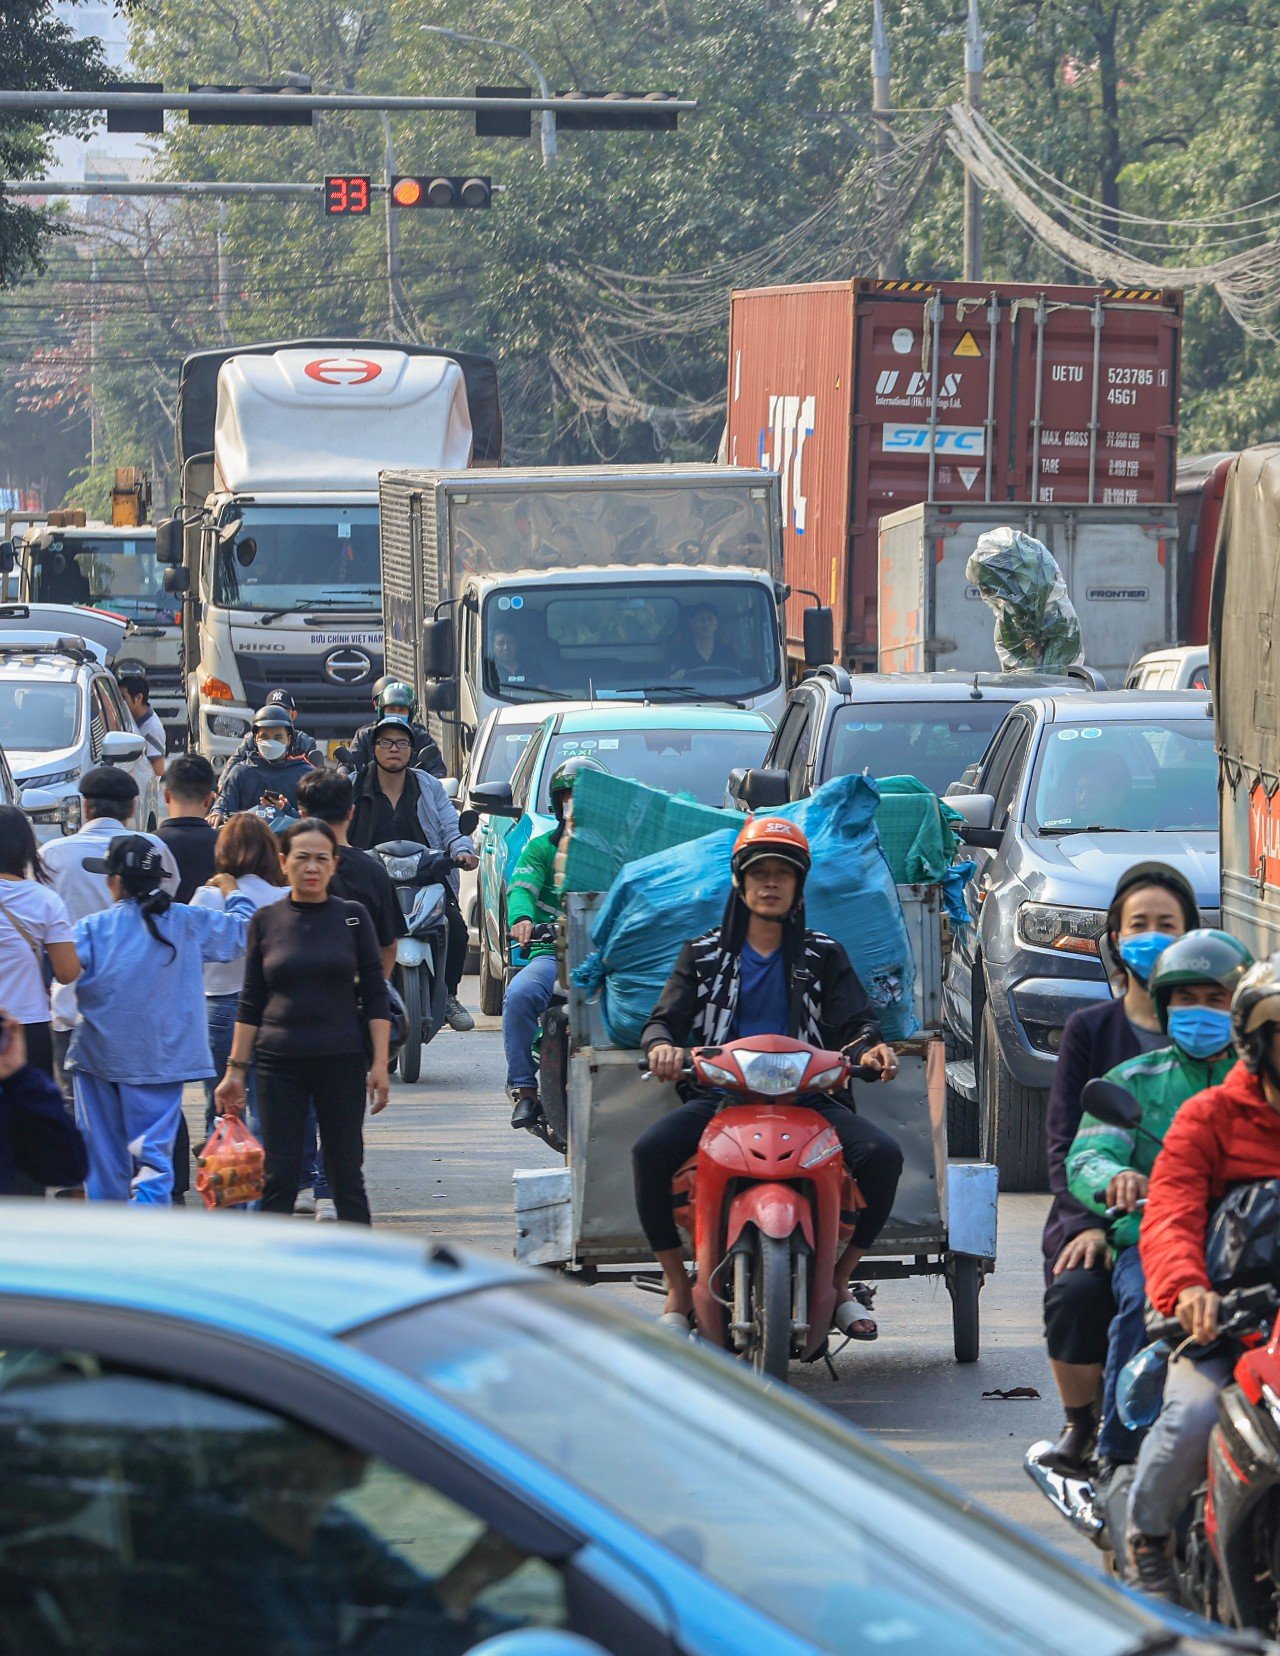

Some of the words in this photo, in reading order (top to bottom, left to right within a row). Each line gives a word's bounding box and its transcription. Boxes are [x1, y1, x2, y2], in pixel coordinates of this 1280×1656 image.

[330, 178, 368, 212] 33
[1052, 365, 1084, 382] UETU
[1108, 368, 1154, 385] 523785
[1107, 388, 1137, 405] 45G1
[885, 428, 983, 449] SITC
[1041, 430, 1062, 446] MAX.
[1064, 431, 1089, 447] GROSS
[1041, 458, 1060, 474] TARE
[1039, 487, 1054, 502] NET
[1090, 590, 1146, 598] FRONTIER
[562, 749, 592, 757] TAXI
